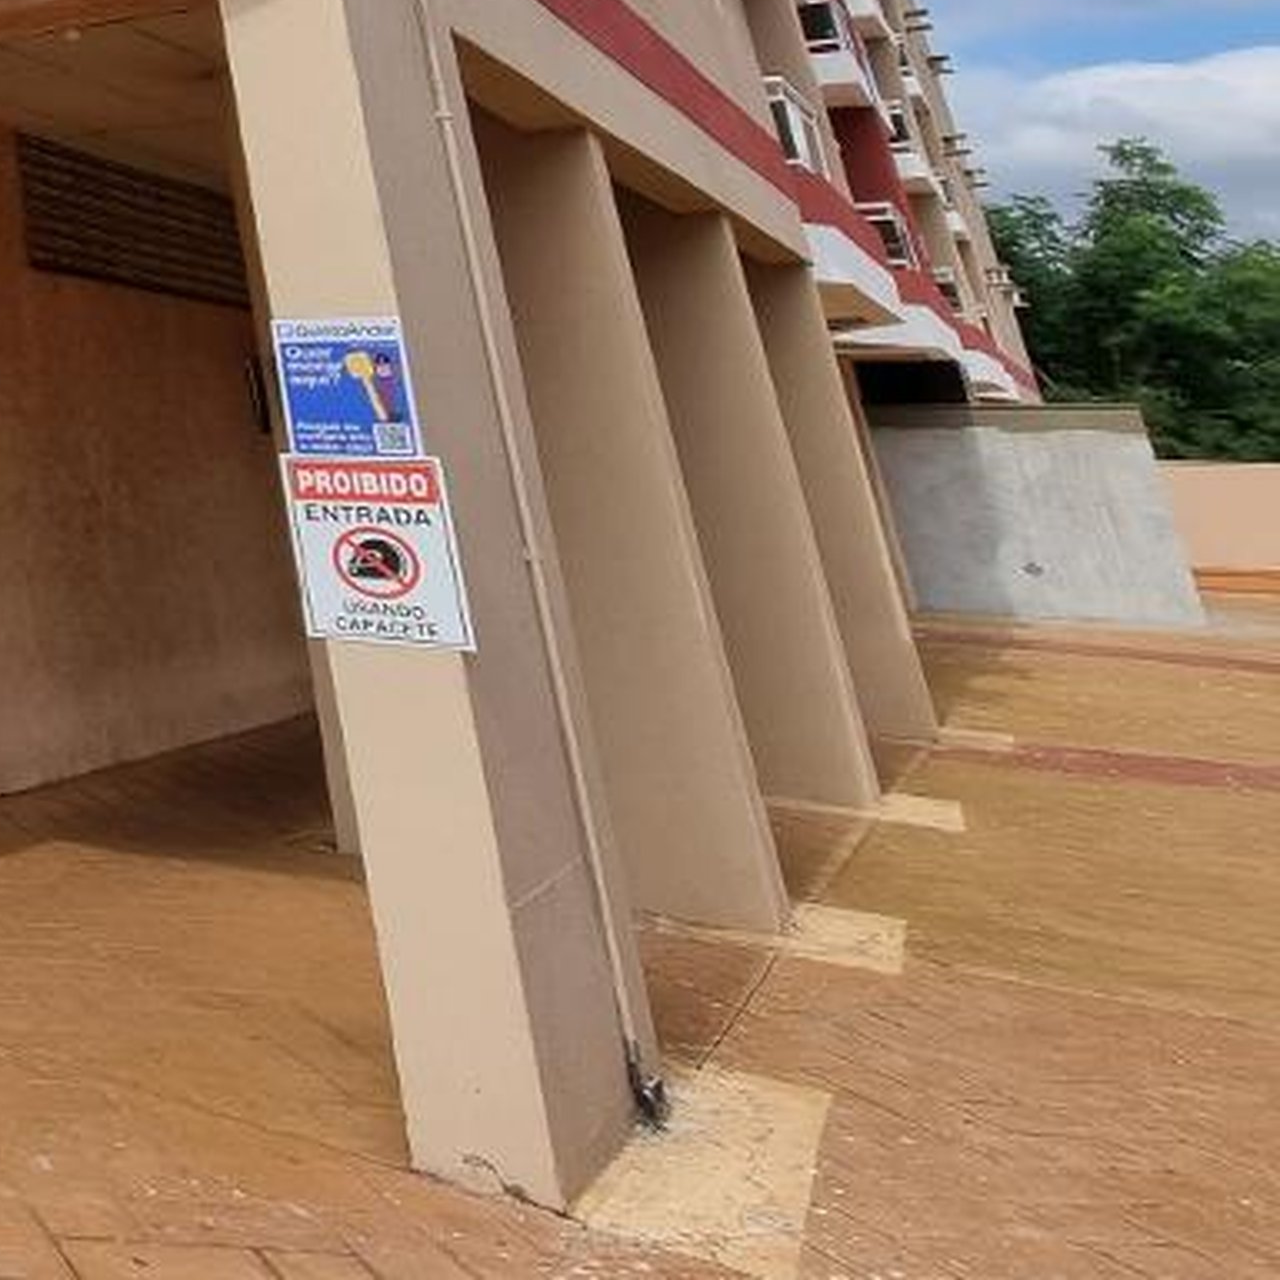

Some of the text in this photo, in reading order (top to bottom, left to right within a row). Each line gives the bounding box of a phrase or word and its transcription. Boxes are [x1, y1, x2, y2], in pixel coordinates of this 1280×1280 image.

[296, 470, 428, 497] PROIBIDO
[305, 504, 431, 526] ENTRADA
[343, 599, 424, 620] USANDO
[336, 616, 438, 635] CAPACETE
